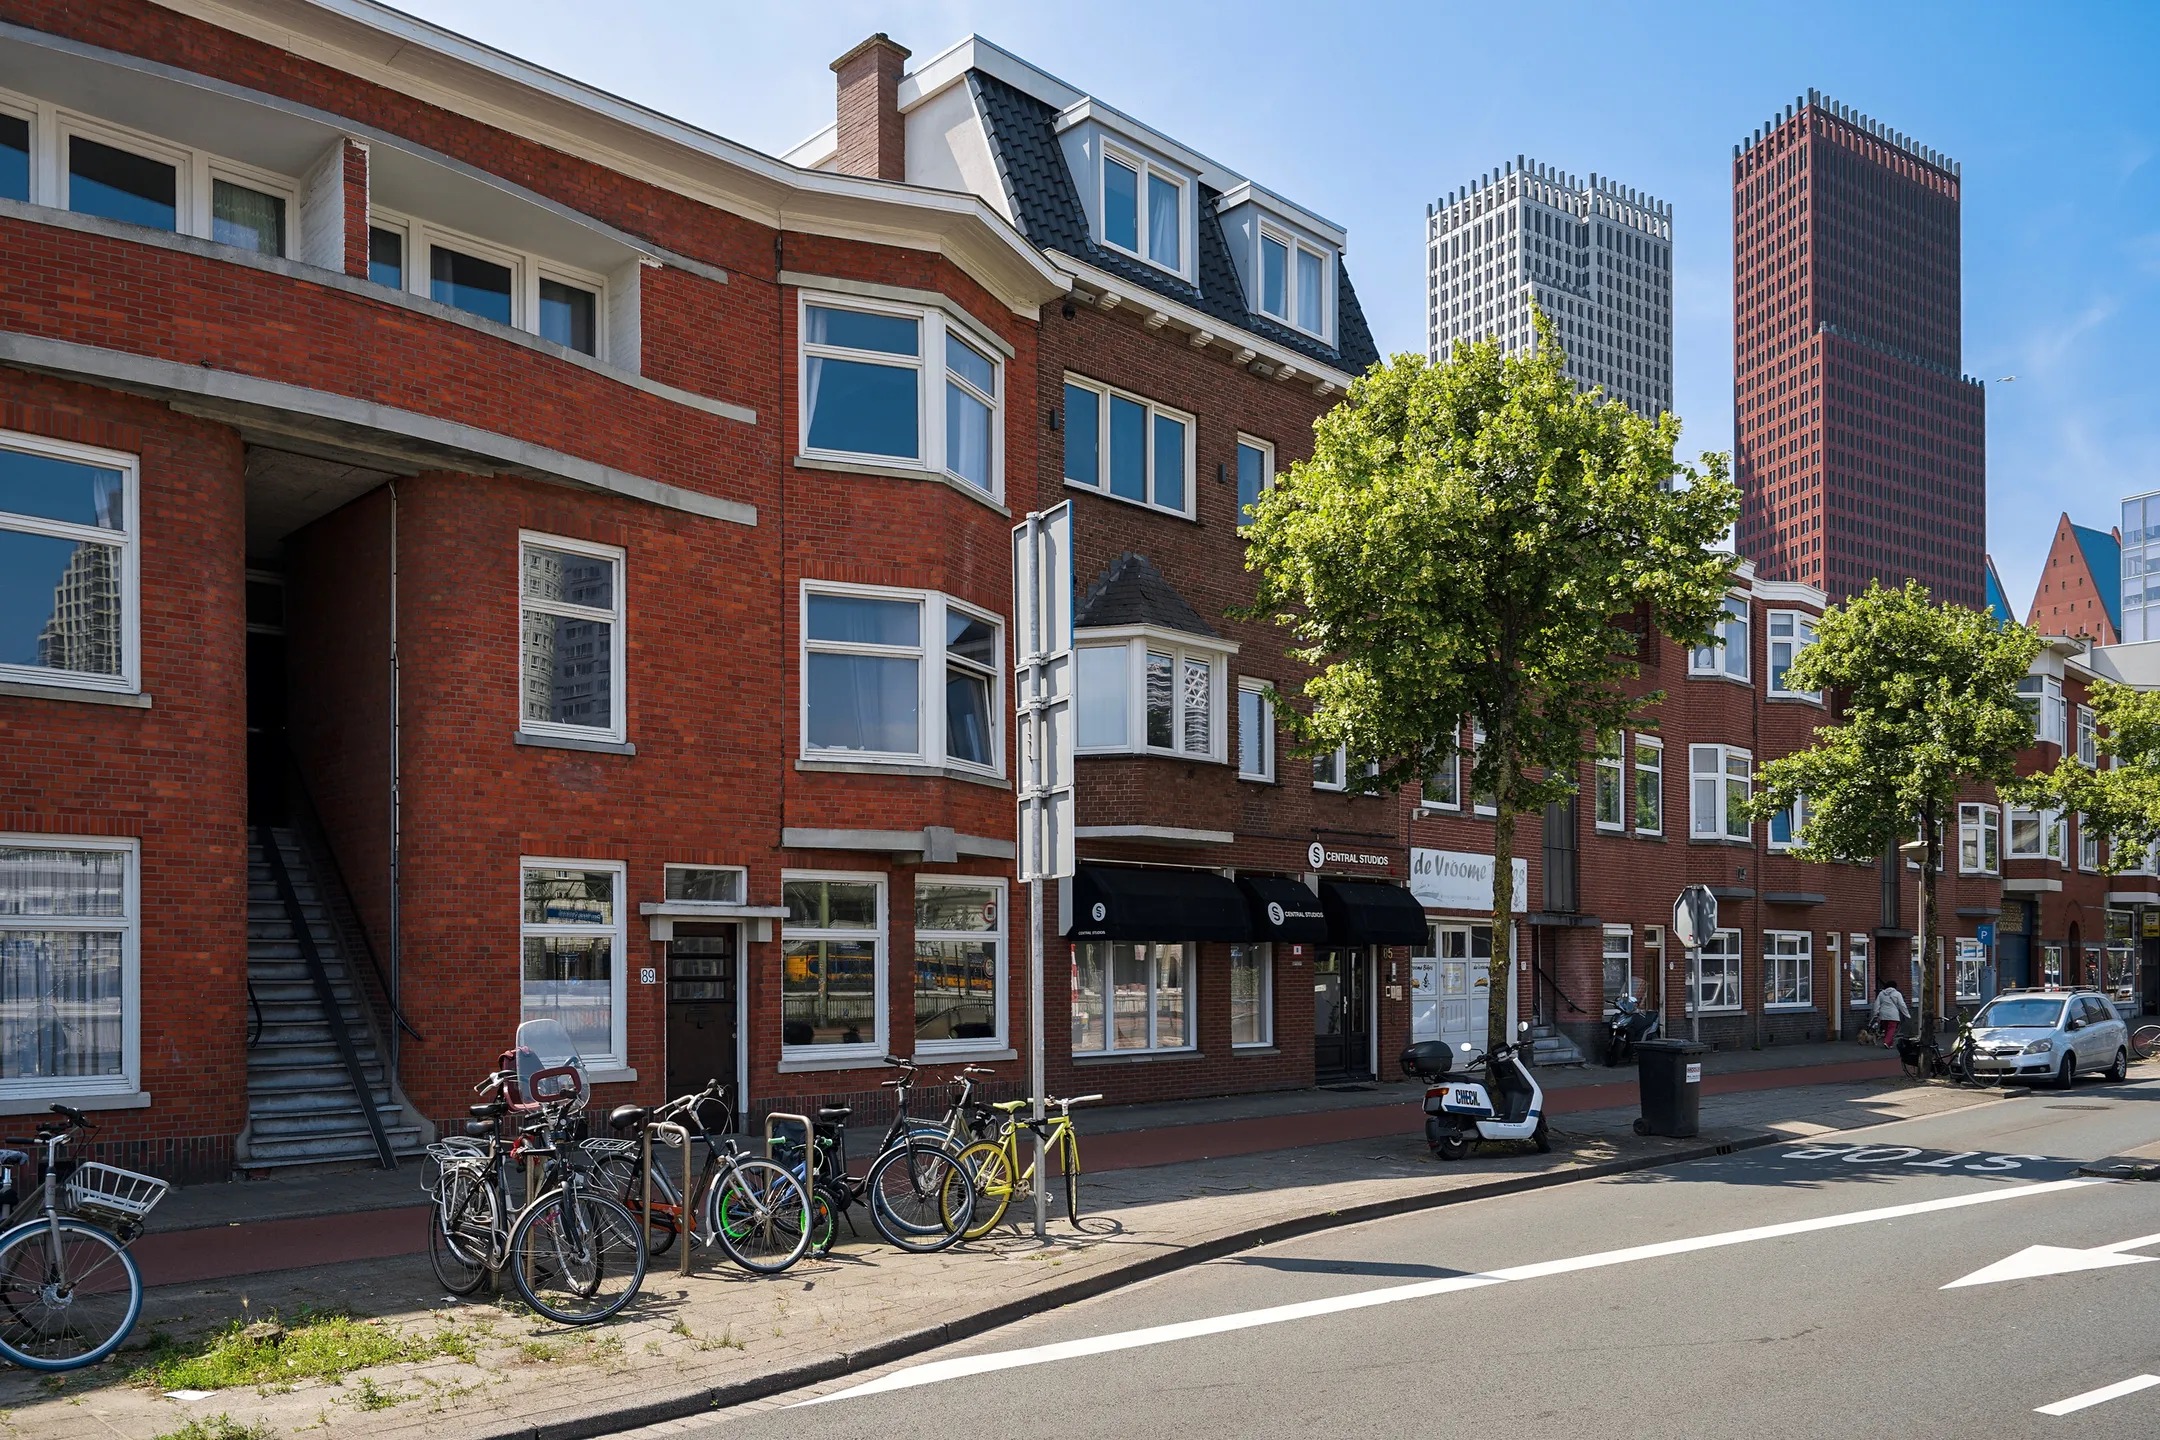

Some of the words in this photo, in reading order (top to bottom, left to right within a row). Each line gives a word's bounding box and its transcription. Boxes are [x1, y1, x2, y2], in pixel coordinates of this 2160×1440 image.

[1325, 851, 1359, 863] CENTRAL
[1359, 854, 1389, 866] STUDIOS
[1414, 852, 1432, 875] de
[1434, 854, 1487, 882] Vroome
[1981, 930, 1988, 940] P
[641, 969, 655, 983] 89
[1781, 1146, 2047, 1171] STOP
